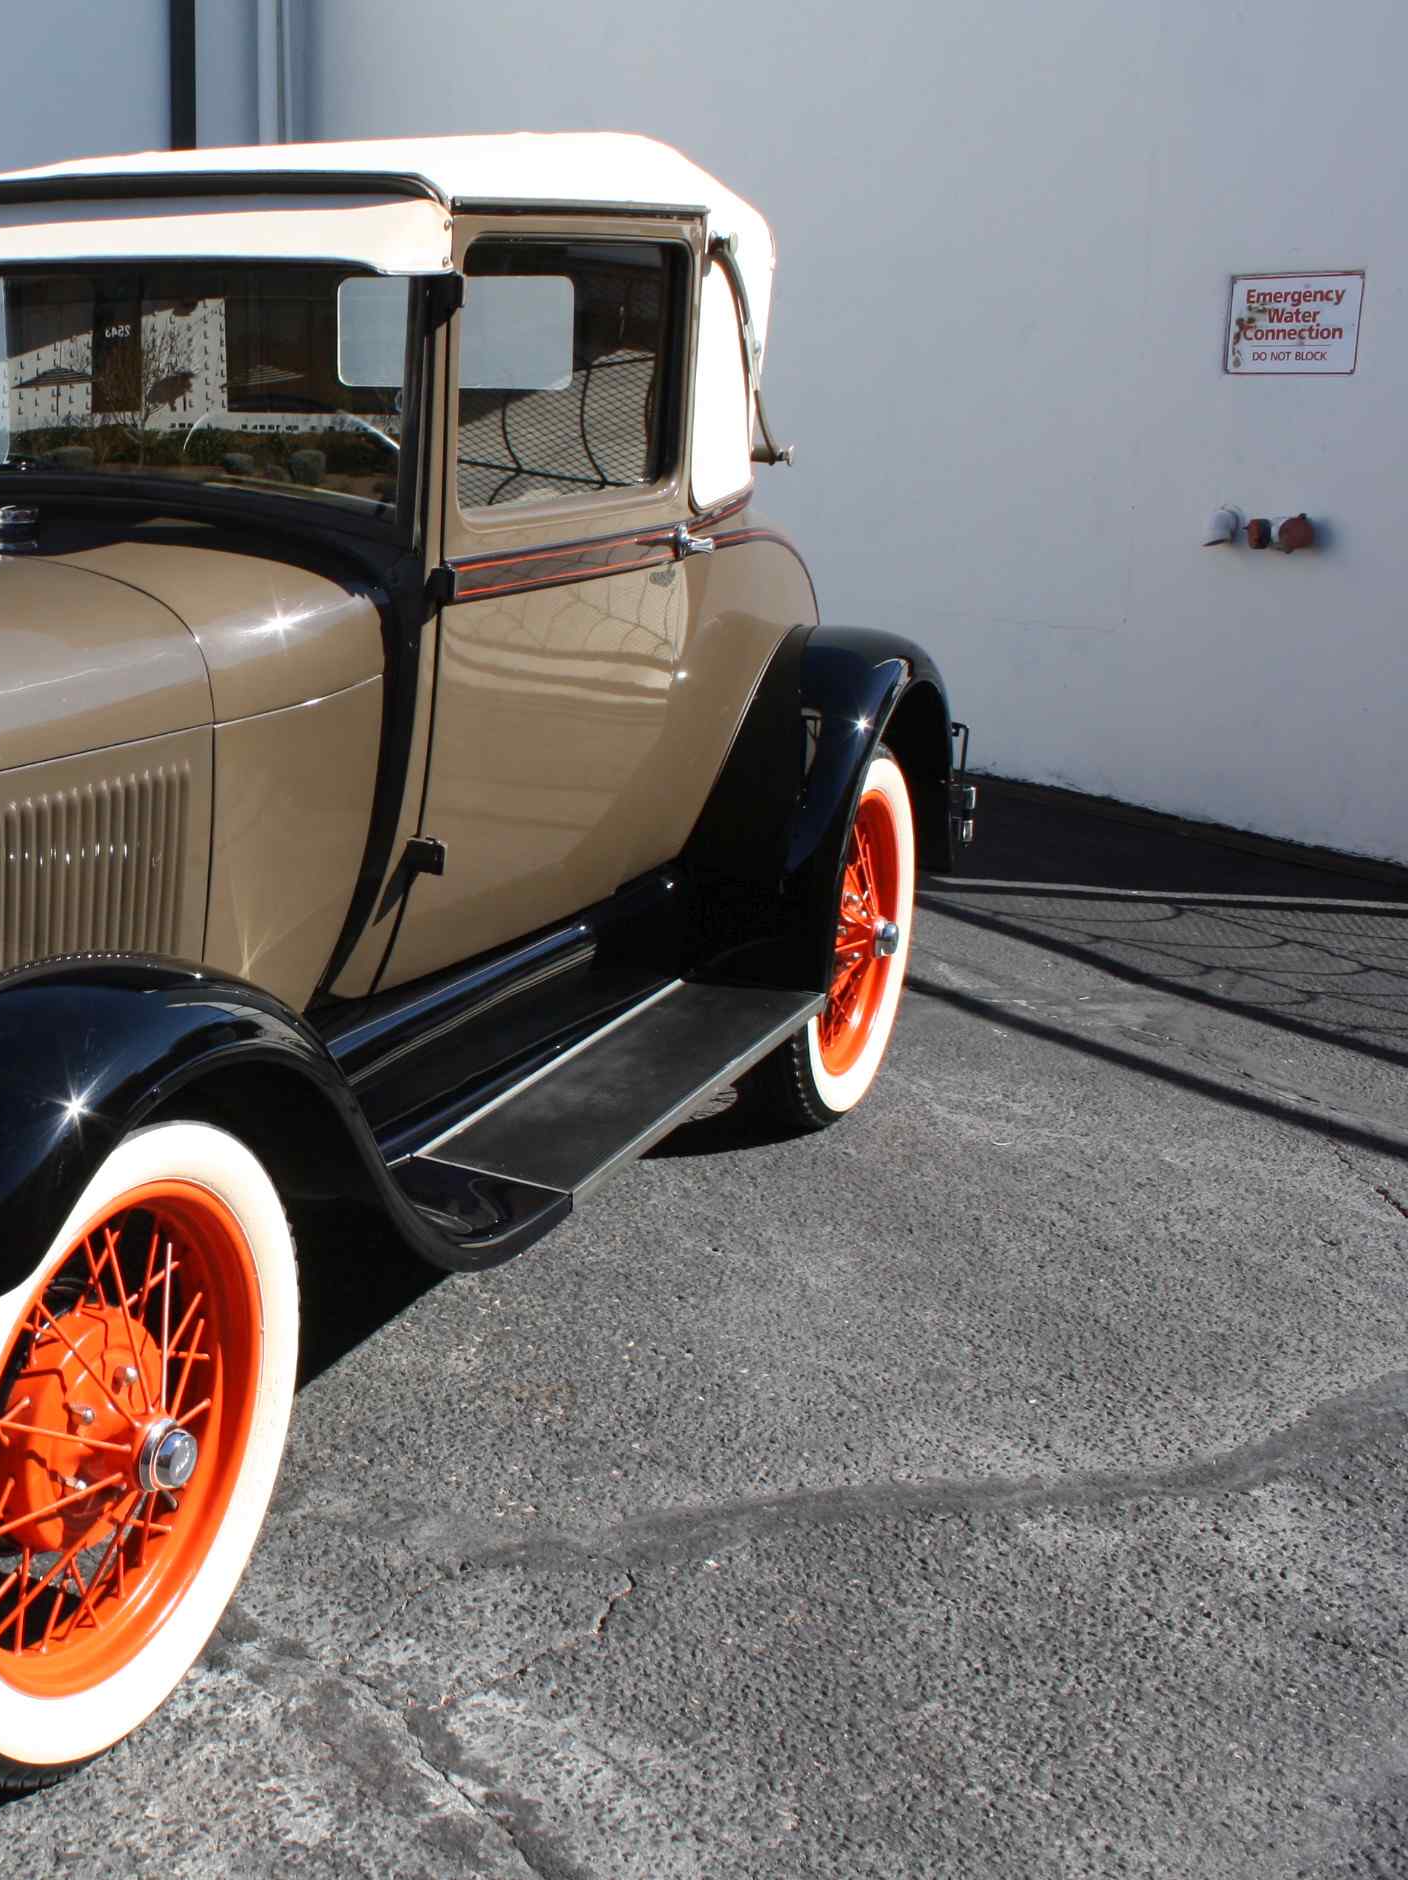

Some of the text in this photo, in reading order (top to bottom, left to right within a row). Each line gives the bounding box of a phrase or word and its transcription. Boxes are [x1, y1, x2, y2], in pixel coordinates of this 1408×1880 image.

[1246, 288, 1347, 307] Emergency
[1266, 307, 1320, 323] Water
[1243, 323, 1344, 341] Connection
[1252, 351, 1328, 361] DO NOT BLOCK
